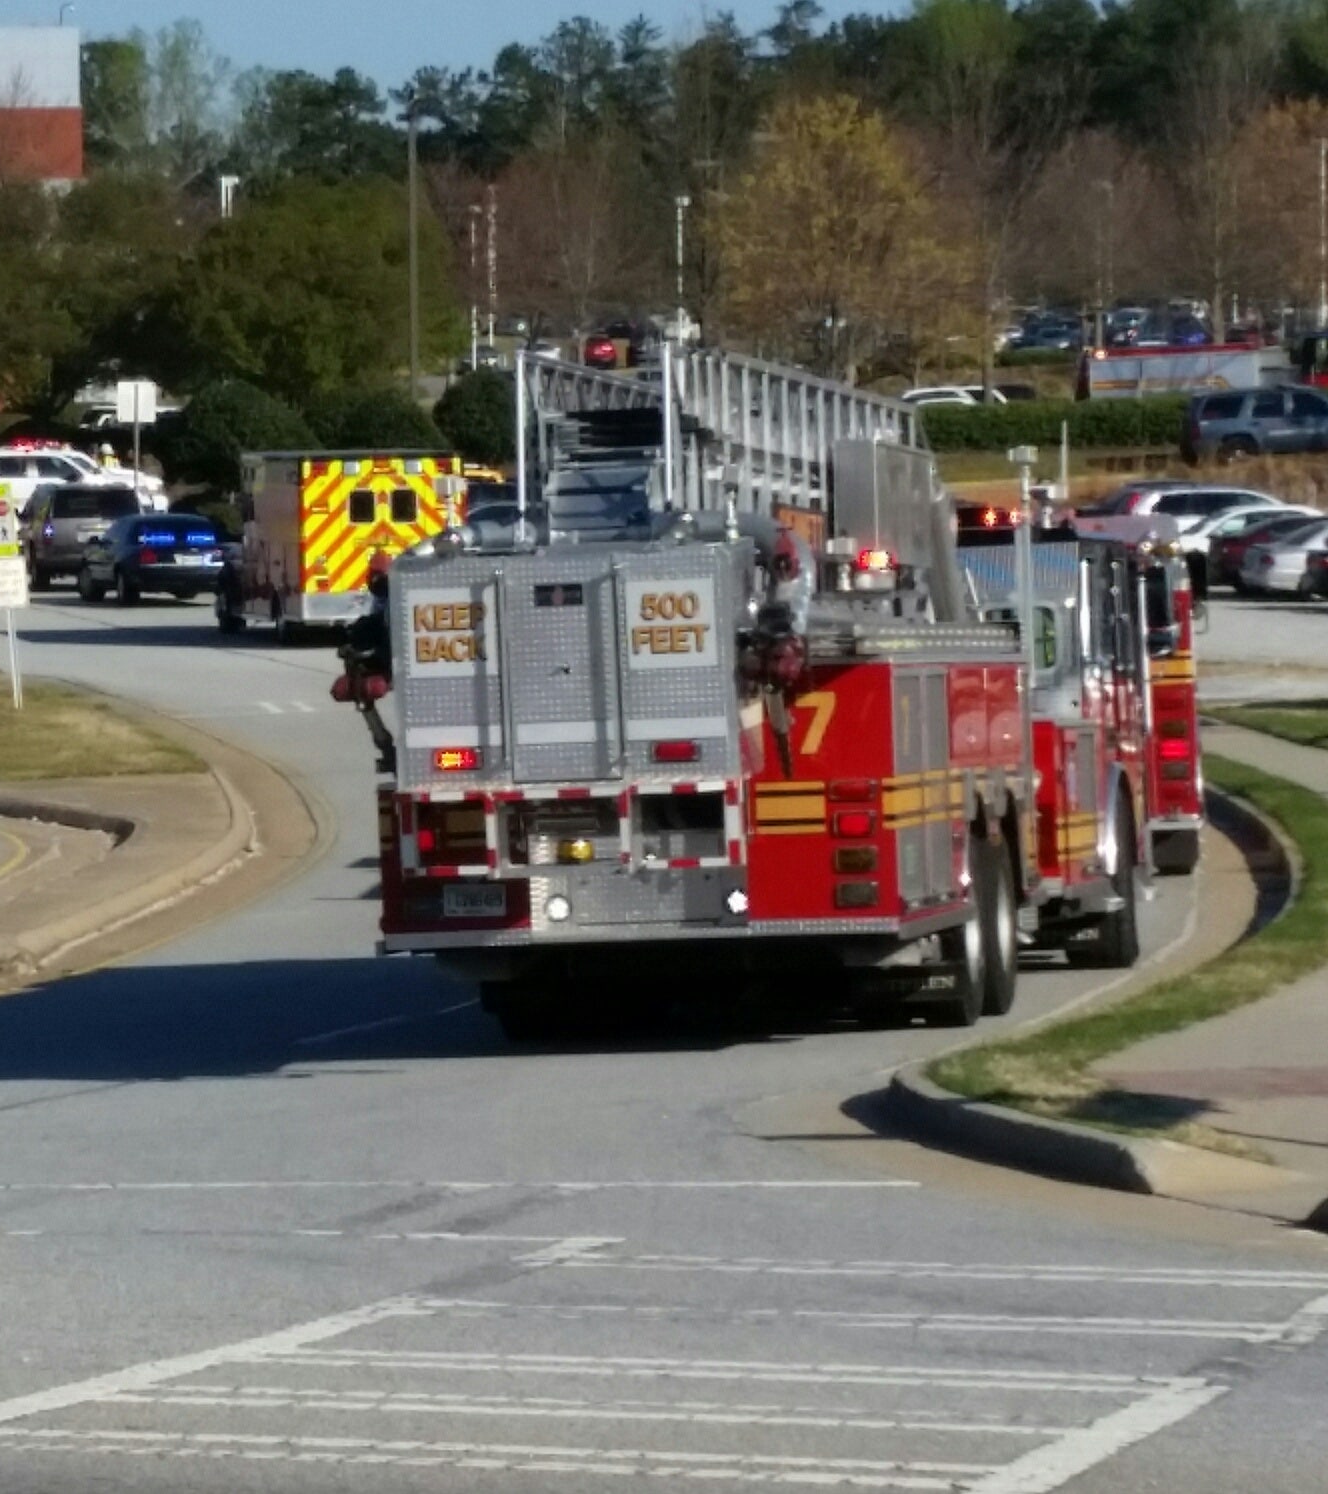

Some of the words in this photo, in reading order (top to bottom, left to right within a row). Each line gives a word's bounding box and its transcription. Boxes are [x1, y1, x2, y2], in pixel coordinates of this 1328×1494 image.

[413, 603, 485, 632] KEEP
[640, 592, 700, 620] 500
[415, 636, 486, 662] BACK
[632, 624, 710, 655] FEET
[794, 691, 836, 755] 7
